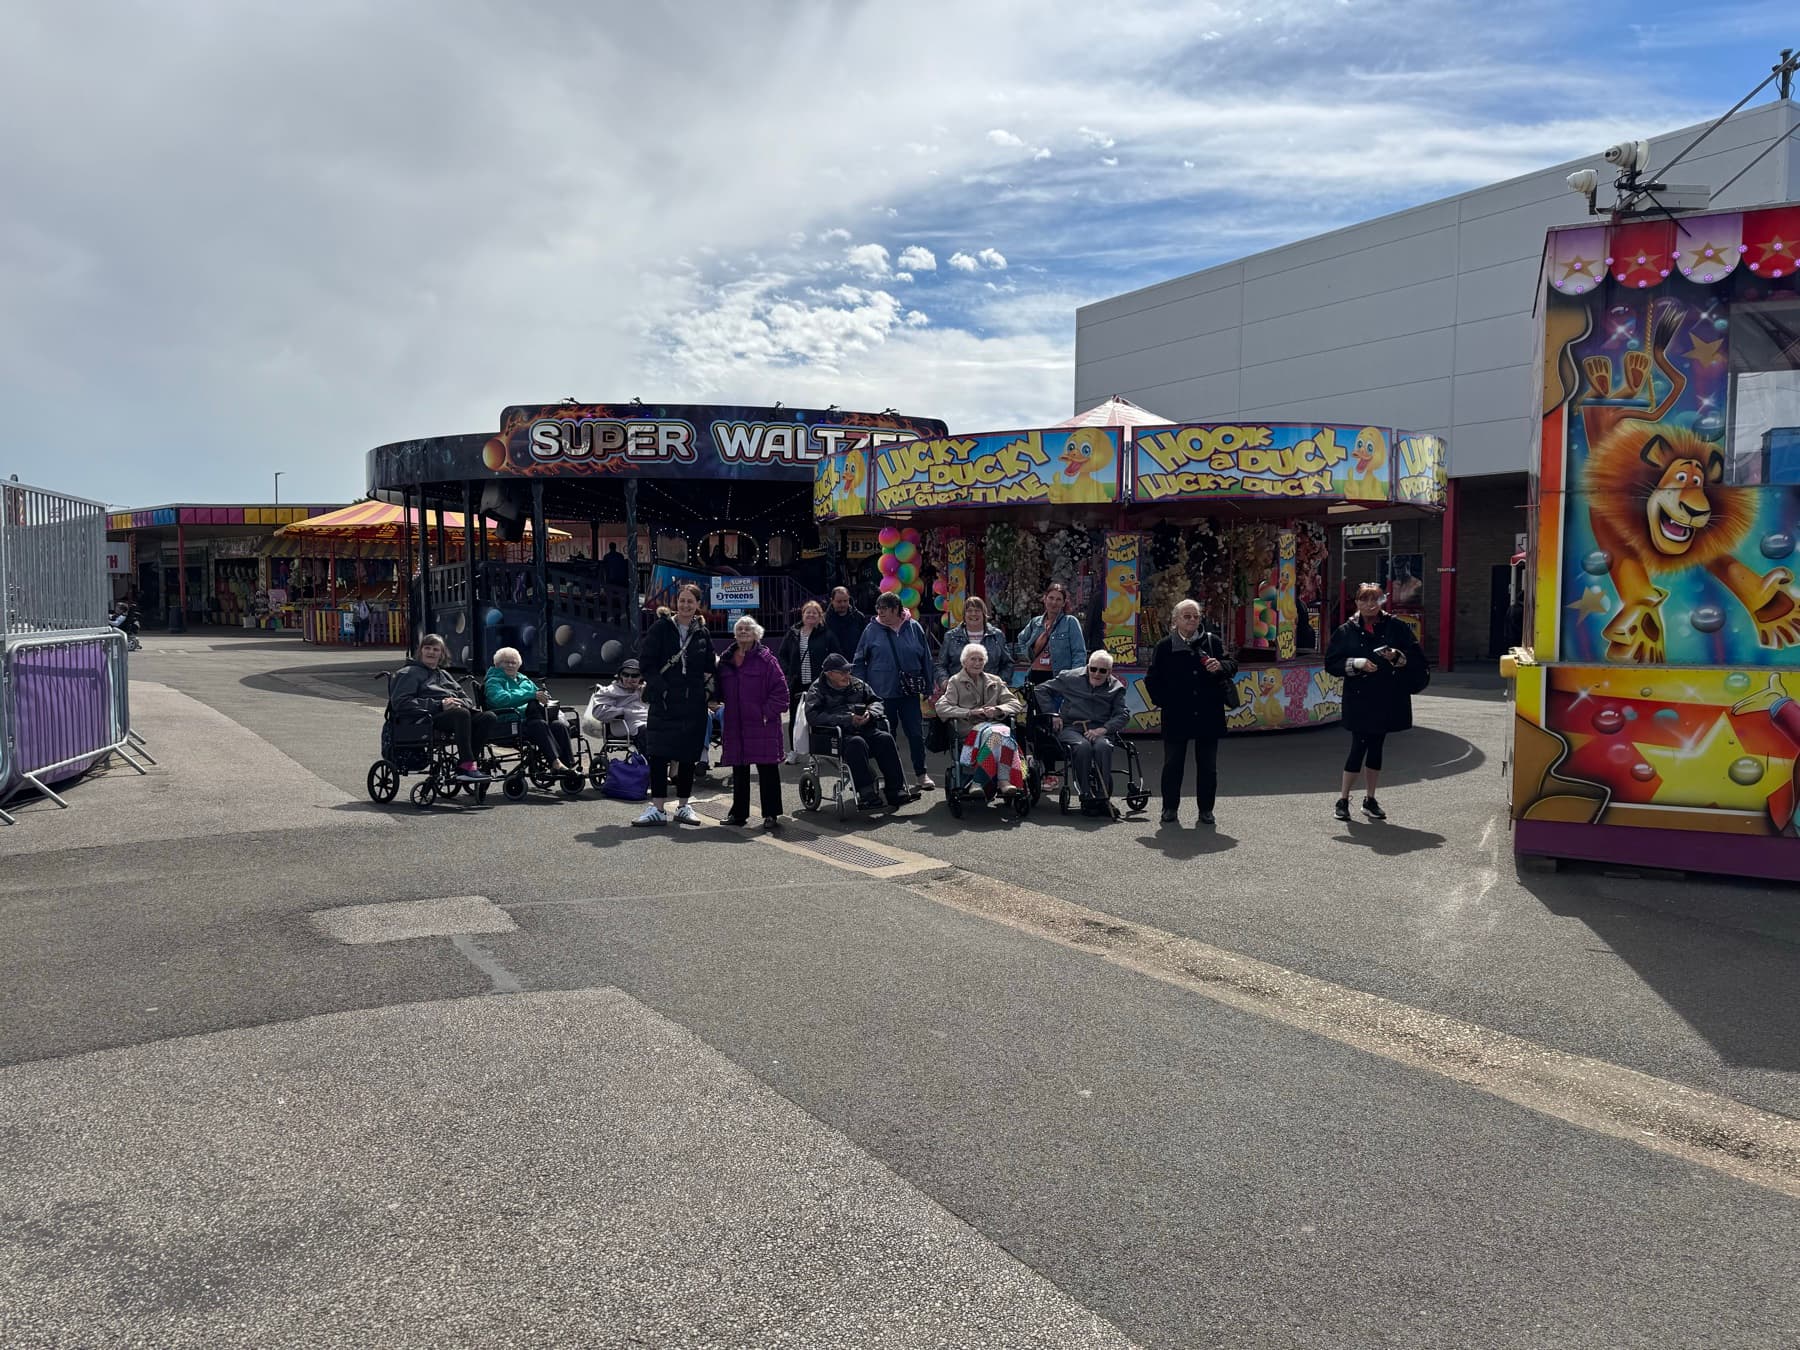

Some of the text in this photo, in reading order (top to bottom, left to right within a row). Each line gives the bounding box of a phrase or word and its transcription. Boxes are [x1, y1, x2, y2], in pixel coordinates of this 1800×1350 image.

[531, 424, 919, 460] SUPER WALTZ
[929, 431, 1050, 486] DUCKY
[1137, 426, 1274, 471] HOOK
[1237, 427, 1347, 475] DUCK
[877, 439, 977, 486] LUCKY
[877, 482, 933, 510] PRIZE
[970, 473, 1049, 503] TIME
[1138, 471, 1334, 499] LUCKY DUCKY
[1107, 535, 1138, 550] LUCKY
[1107, 543, 1138, 561] DUCKY
